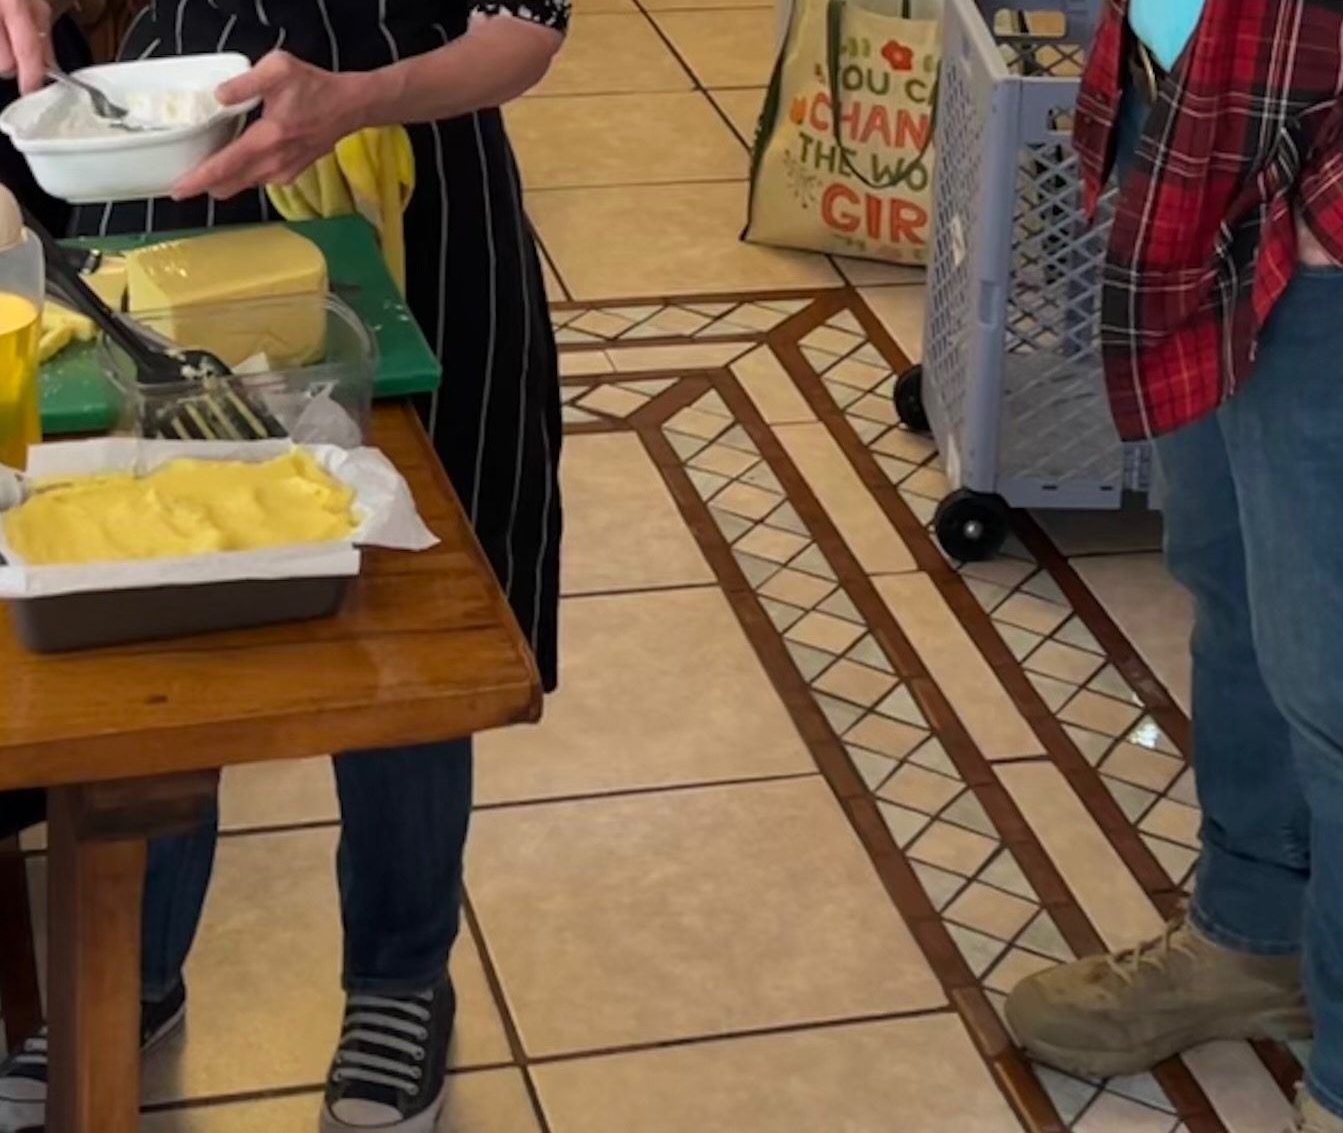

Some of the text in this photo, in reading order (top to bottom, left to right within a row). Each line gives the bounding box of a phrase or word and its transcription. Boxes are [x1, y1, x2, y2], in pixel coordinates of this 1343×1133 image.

[815, 63, 890, 95] OU
[799, 132, 857, 178] THE
[820, 183, 929, 245] GIR
